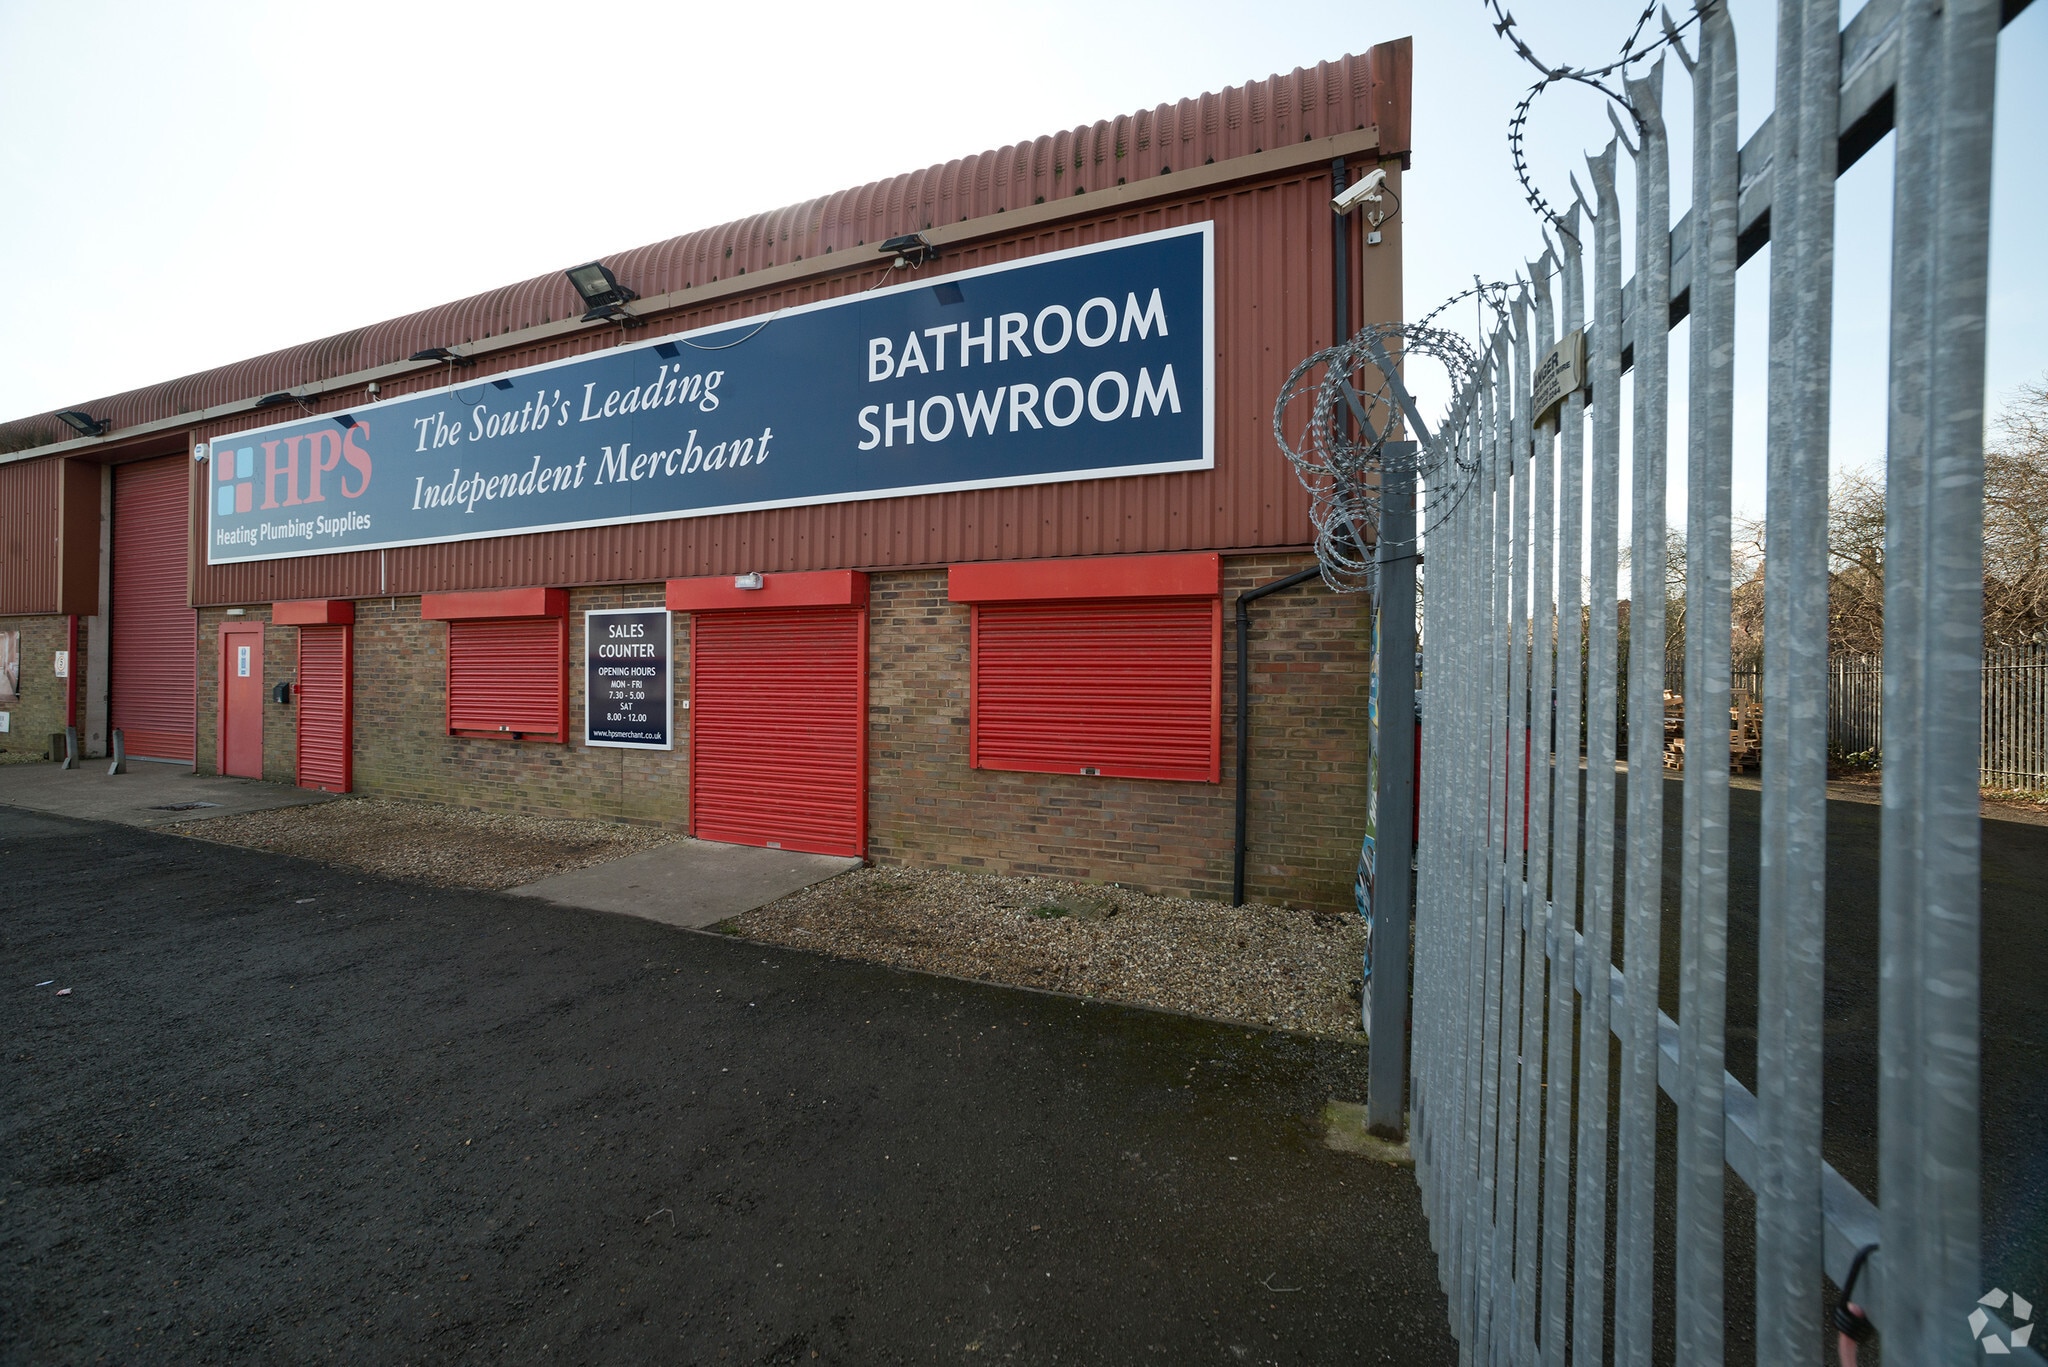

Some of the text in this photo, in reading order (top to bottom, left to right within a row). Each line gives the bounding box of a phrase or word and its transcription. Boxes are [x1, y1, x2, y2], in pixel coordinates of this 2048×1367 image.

[868, 288, 1169, 383] BATHROOM
[413, 363, 725, 452] The South's Leading
[858, 364, 1182, 450] SHOWROOM
[260, 421, 373, 510] HPS
[411, 427, 774, 514] Independent Merchant
[216, 511, 371, 546] Heating Plumbing Supplies
[609, 624, 644, 638] SALES
[599, 644, 655, 658] COUNTER
[598, 667, 656, 676] OPENING HOURS
[611, 680, 626, 688] MON
[631, 680, 643, 688] FRI
[609, 691, 624, 699] 7.30
[629, 691, 645, 700] 5.00
[620, 702, 633, 710] SAT
[606, 712, 622, 721] 8.00
[628, 713, 647, 722] 12.00
[593, 729, 662, 740] www.hpsmerchant.co.uk
